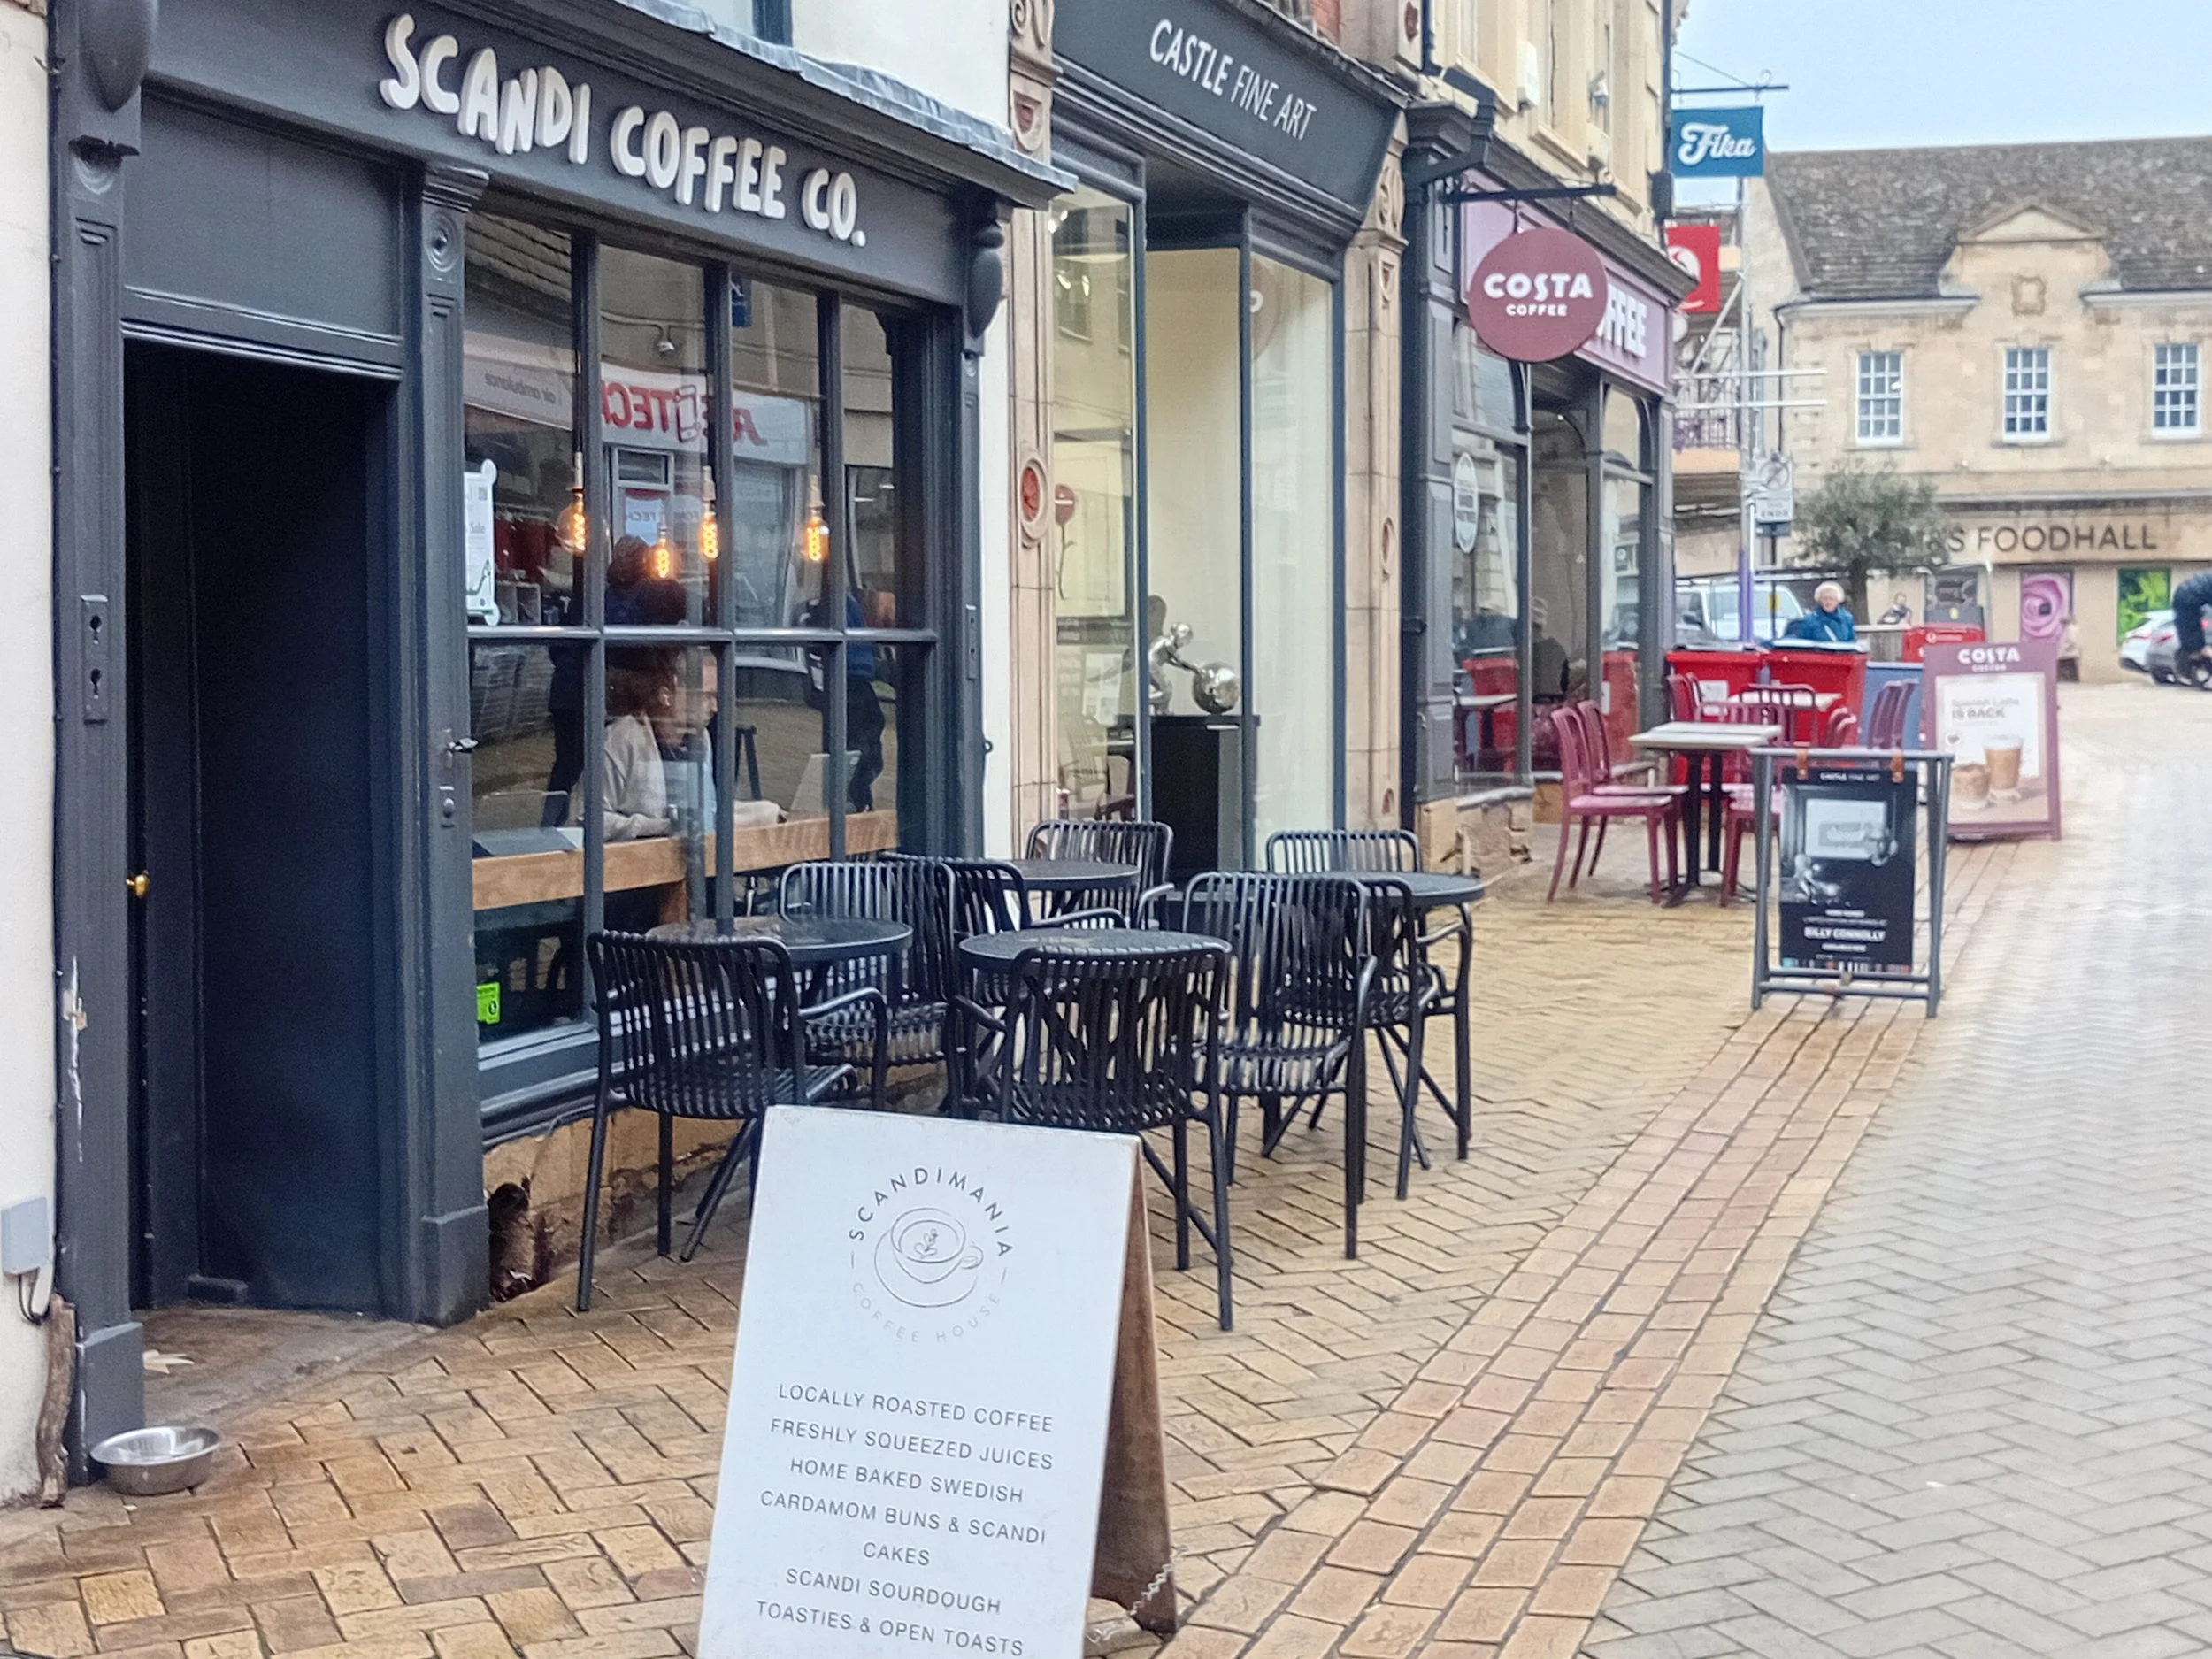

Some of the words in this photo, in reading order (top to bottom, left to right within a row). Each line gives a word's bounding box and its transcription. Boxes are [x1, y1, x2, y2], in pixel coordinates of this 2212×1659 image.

[1150, 19, 1234, 97] CASTLE
[1230, 65, 1279, 122] FINE
[1273, 93, 1317, 142] ART
[380, 12, 592, 165] SCANDI
[611, 104, 787, 220] COFFEE
[802, 167, 866, 248] CO.
[1678, 121, 1758, 166] Fika
[1483, 272, 1594, 300] COSTA
[1505, 303, 1568, 318] COFFEE
[1596, 282, 1647, 358] FFEE
[1978, 523, 2158, 553] FOODHALL
[1957, 646, 2021, 664] COSTA
[849, 1167, 1013, 1257] SCANDIMANIA
[852, 1282, 920, 1343] COFFEE
[935, 1293, 1001, 1343] HOUSE
[778, 1383, 865, 1408] LOCALLY
[872, 1394, 966, 1421] ROASTED
[973, 1407, 1054, 1433] COFFEE
[771, 1418, 856, 1443] FRESHLY
[864, 1430, 972, 1459] SQUEEZED
[979, 1446, 1054, 1471] JUICES
[790, 1457, 849, 1479] HOME
[856, 1465, 922, 1490] BAKED
[930, 1475, 1024, 1502] SWEDISH
[760, 1490, 877, 1521] CARDAMOM
[885, 1507, 941, 1530] BUNS
[949, 1517, 960, 1533] &
[968, 1518, 1046, 1545] SCANDI
[863, 1541, 931, 1567] CAKES
[786, 1567, 861, 1594] SCANDI
[868, 1579, 1001, 1615] SOURDOUGH
[757, 1600, 852, 1631] TOASTIES
[859, 1617, 871, 1634] &
[879, 1619, 935, 1644] OPEN
[943, 1628, 1025, 1657] TOASTS
